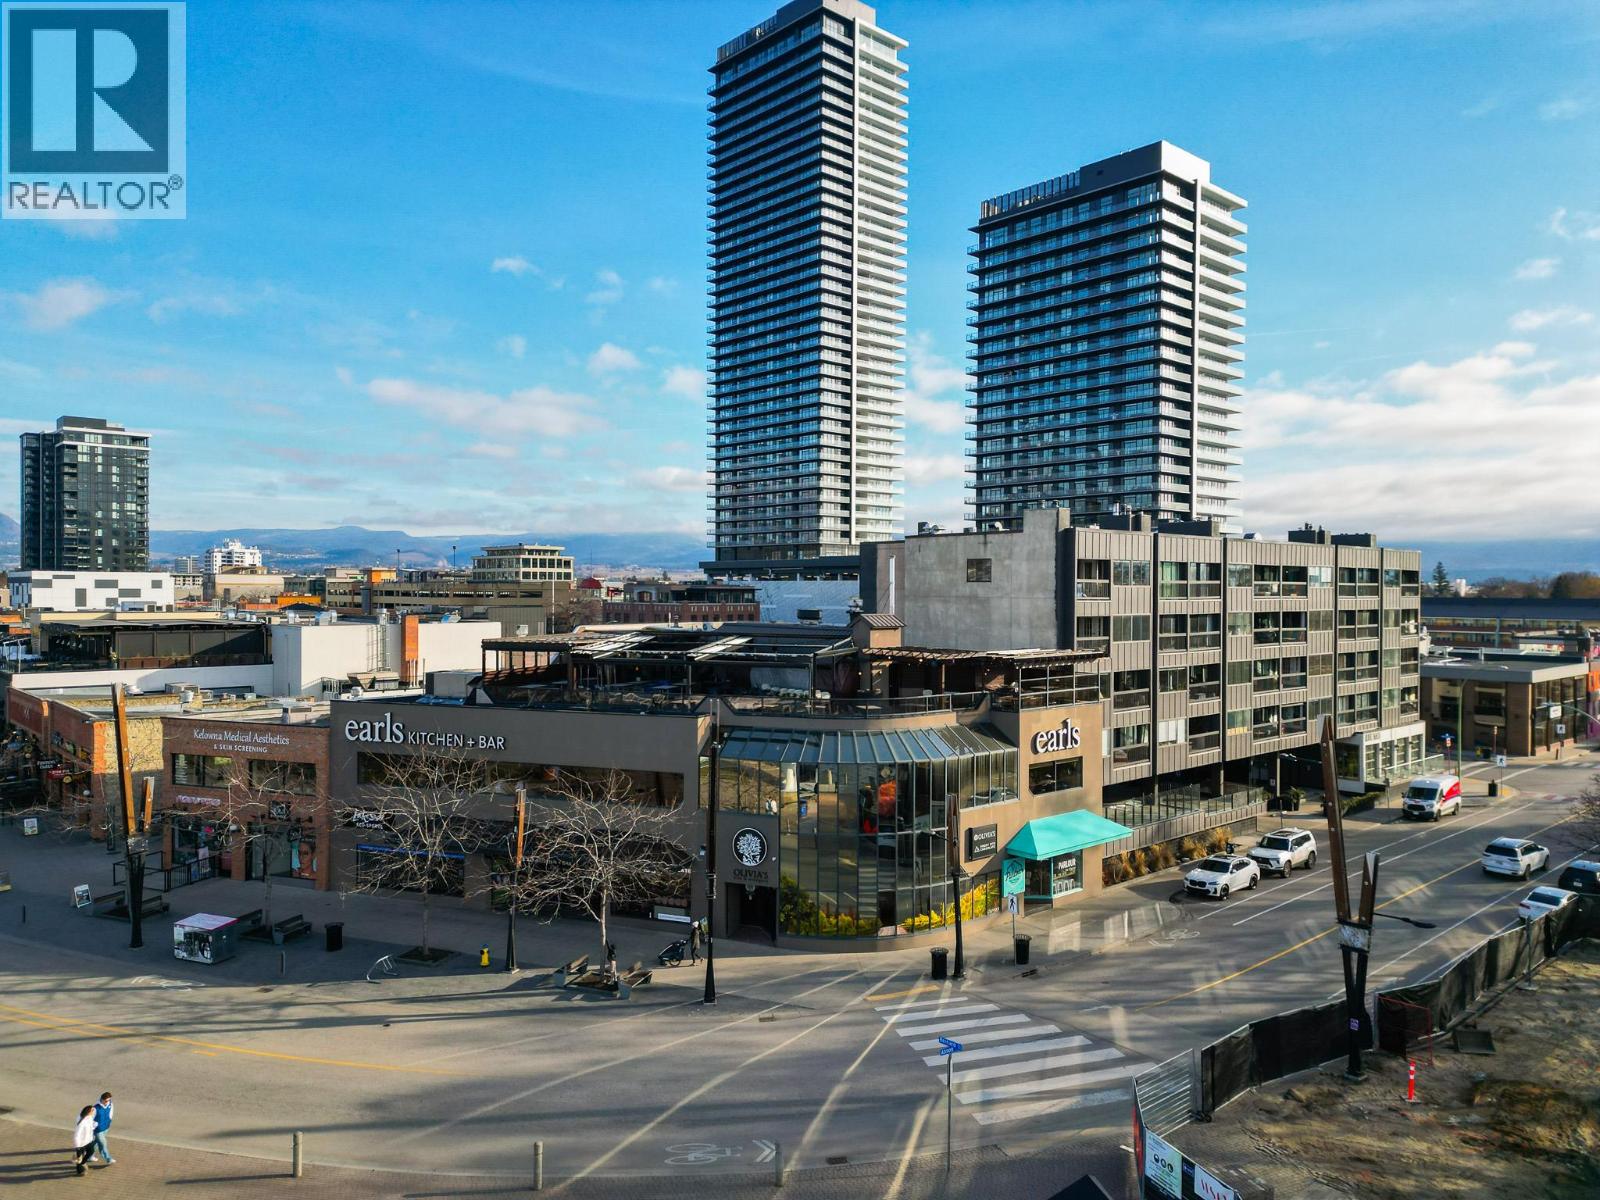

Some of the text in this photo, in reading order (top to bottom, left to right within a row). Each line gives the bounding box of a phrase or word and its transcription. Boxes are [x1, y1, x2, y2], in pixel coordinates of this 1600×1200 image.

[193, 728, 290, 745] Kelowna Medical Aesthetics
[345, 712, 505, 750] earls KITCHEN + BAR
[1034, 718, 1081, 753] earls
[219, 743, 233, 751] SKIN
[234, 744, 268, 753] SCREENING
[1058, 858, 1077, 870] PARLOUR
[733, 868, 769, 879] OLIVIA'S
